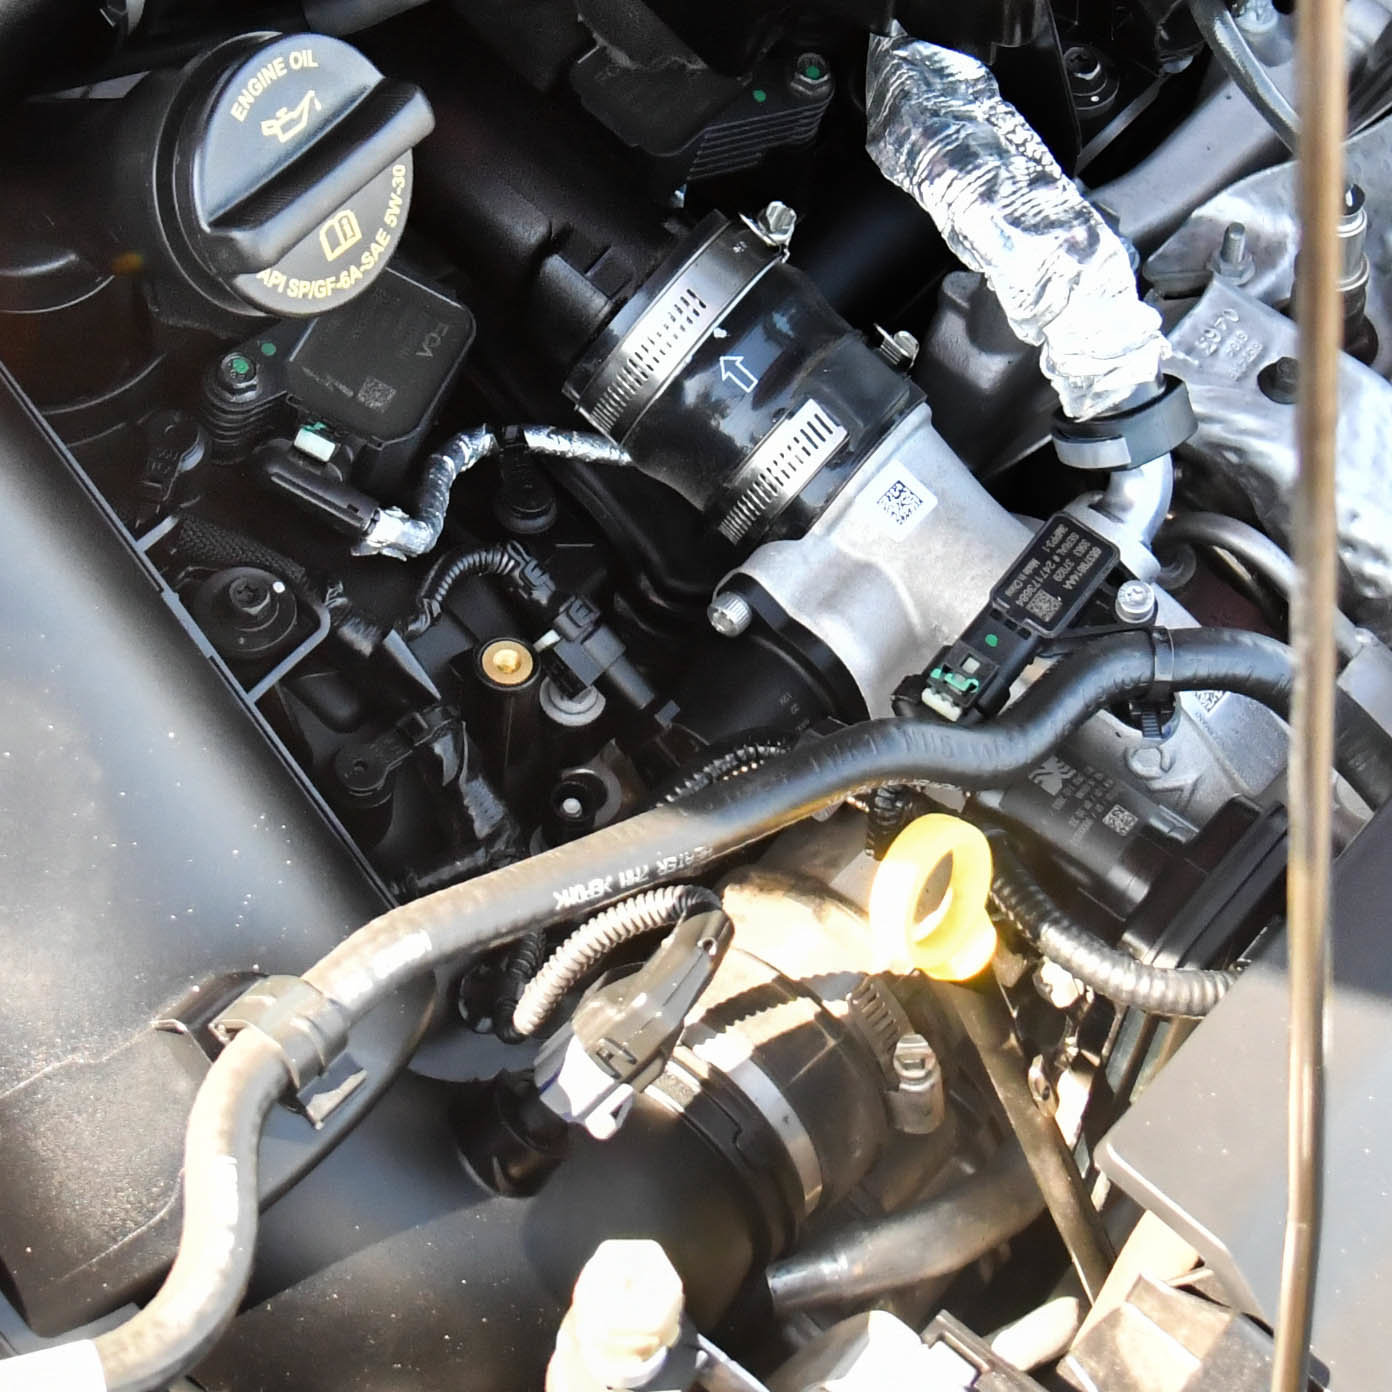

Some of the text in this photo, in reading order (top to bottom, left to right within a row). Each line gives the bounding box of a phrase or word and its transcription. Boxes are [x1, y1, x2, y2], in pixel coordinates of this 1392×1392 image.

[230, 49, 319, 122] ENGINE OIL
[256, 266, 287, 294] API
[387, 164, 407, 227] 5W-30
